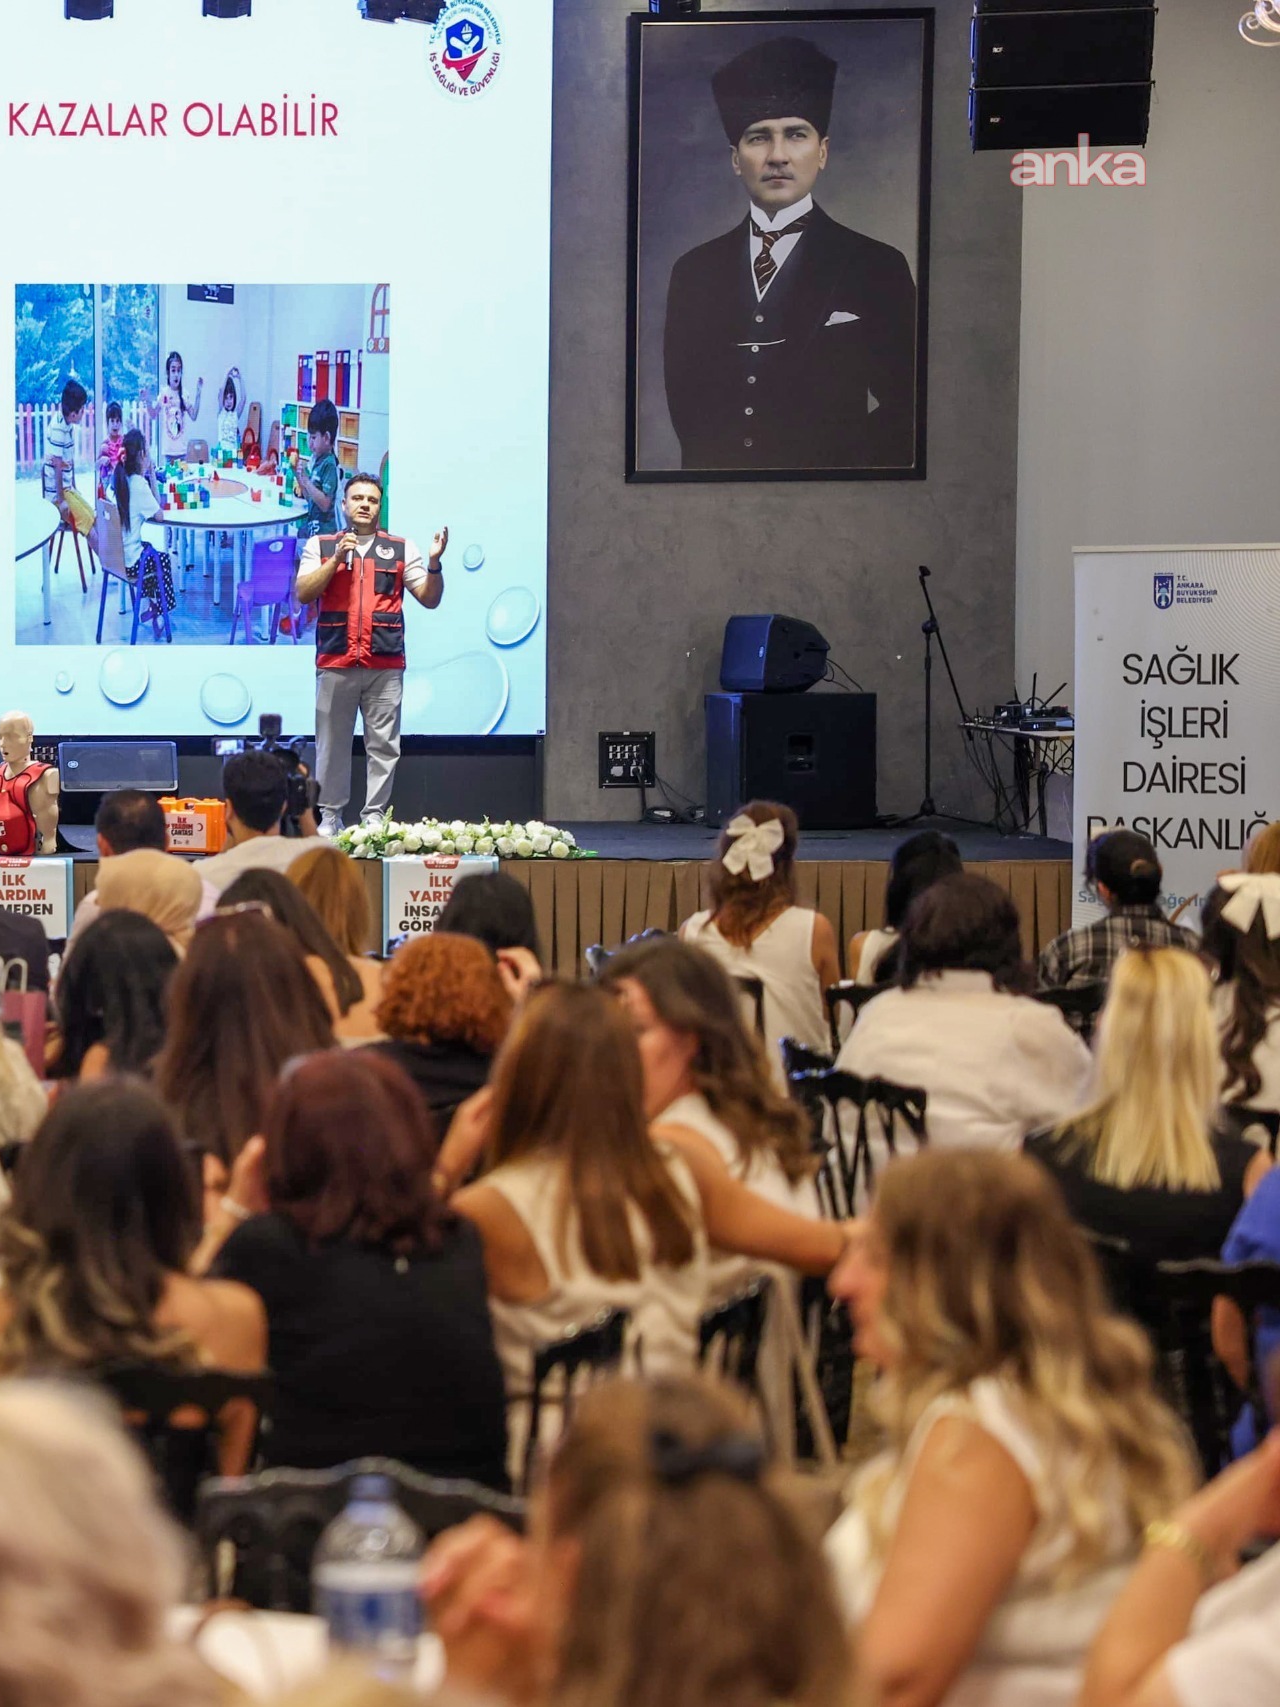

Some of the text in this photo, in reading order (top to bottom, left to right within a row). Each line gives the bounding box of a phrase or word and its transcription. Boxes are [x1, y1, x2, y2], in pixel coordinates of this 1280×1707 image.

[458, 86, 469, 96] VE
[8, 102, 168, 137] KAZALAR
[183, 93, 339, 137] OLABİLİR
[1123, 645, 1240, 686] SAĞLIK
[1140, 700, 1229, 749] İŞLERİ
[1123, 755, 1246, 794] DAİRESİ
[2, 871, 26, 886] İLK
[429, 872, 454, 888] İLK
[409, 890, 453, 903] YARD
[404, 902, 440, 917] İNSA
